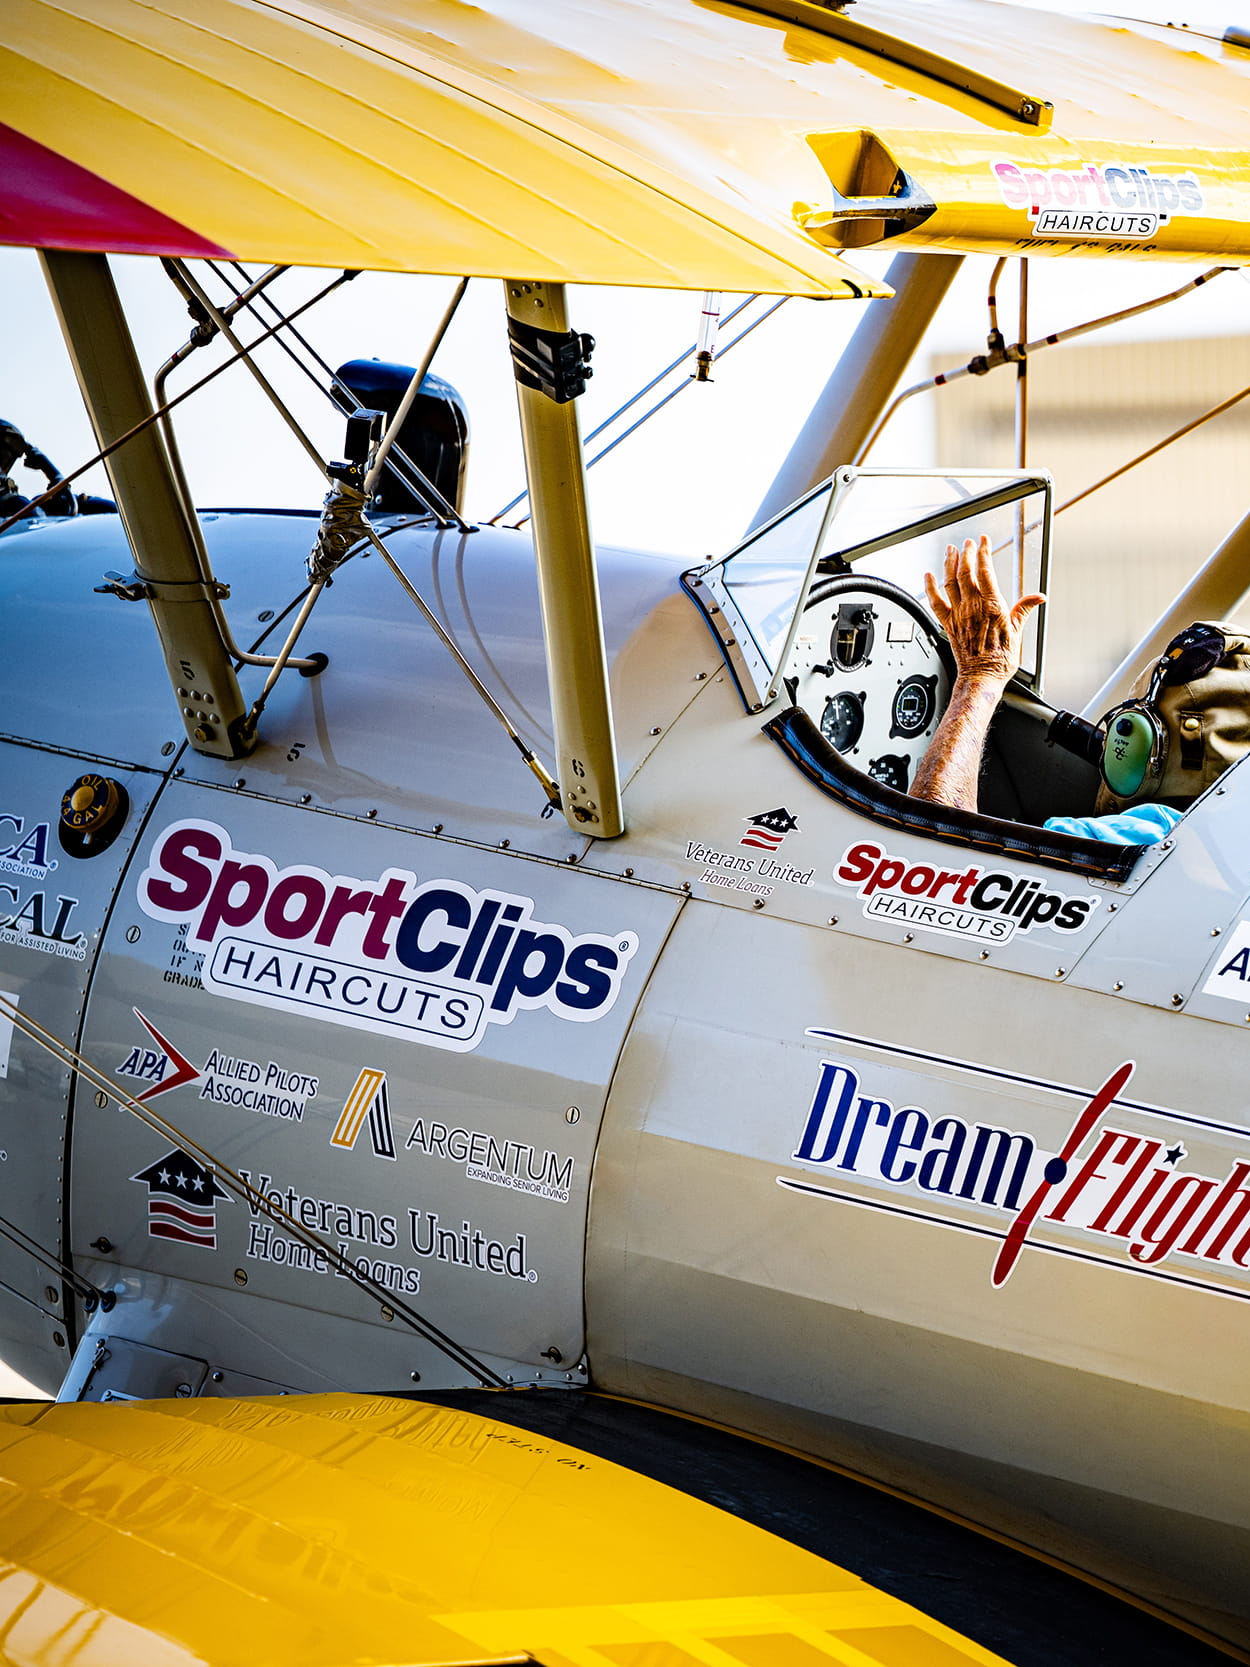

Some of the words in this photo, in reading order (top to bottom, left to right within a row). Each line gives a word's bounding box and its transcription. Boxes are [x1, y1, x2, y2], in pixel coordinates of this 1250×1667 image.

[1043, 214, 1151, 233] HAIRCUTS
[82, 775, 102, 791] OIL
[73, 804, 103, 825] GAL
[686, 842, 754, 872] Veterans
[758, 859, 814, 885] United
[699, 869, 735, 888] Home
[736, 877, 773, 896] Loans
[875, 896, 1007, 938] HAIRCUTS
[19, 936, 57, 953] ASSISTED
[57, 945, 85, 960] LIVING
[222, 945, 470, 1029] HAIRCUTS
[118, 1048, 168, 1081] APA
[204, 1050, 260, 1083] ALLIED
[265, 1063, 318, 1098] PILOTS
[201, 1076, 304, 1121] ASSOCIATION
[407, 1120, 573, 1188] ARGENTUM
[795, 1063, 1034, 1212] Dream
[467, 1167, 512, 1186] EXPANDING
[513, 1178, 541, 1195] SENIOR
[542, 1186, 568, 1202] LIVING
[240, 1171, 397, 1248] Veterans
[248, 1224, 329, 1273] Home
[337, 1244, 419, 1293] Loans
